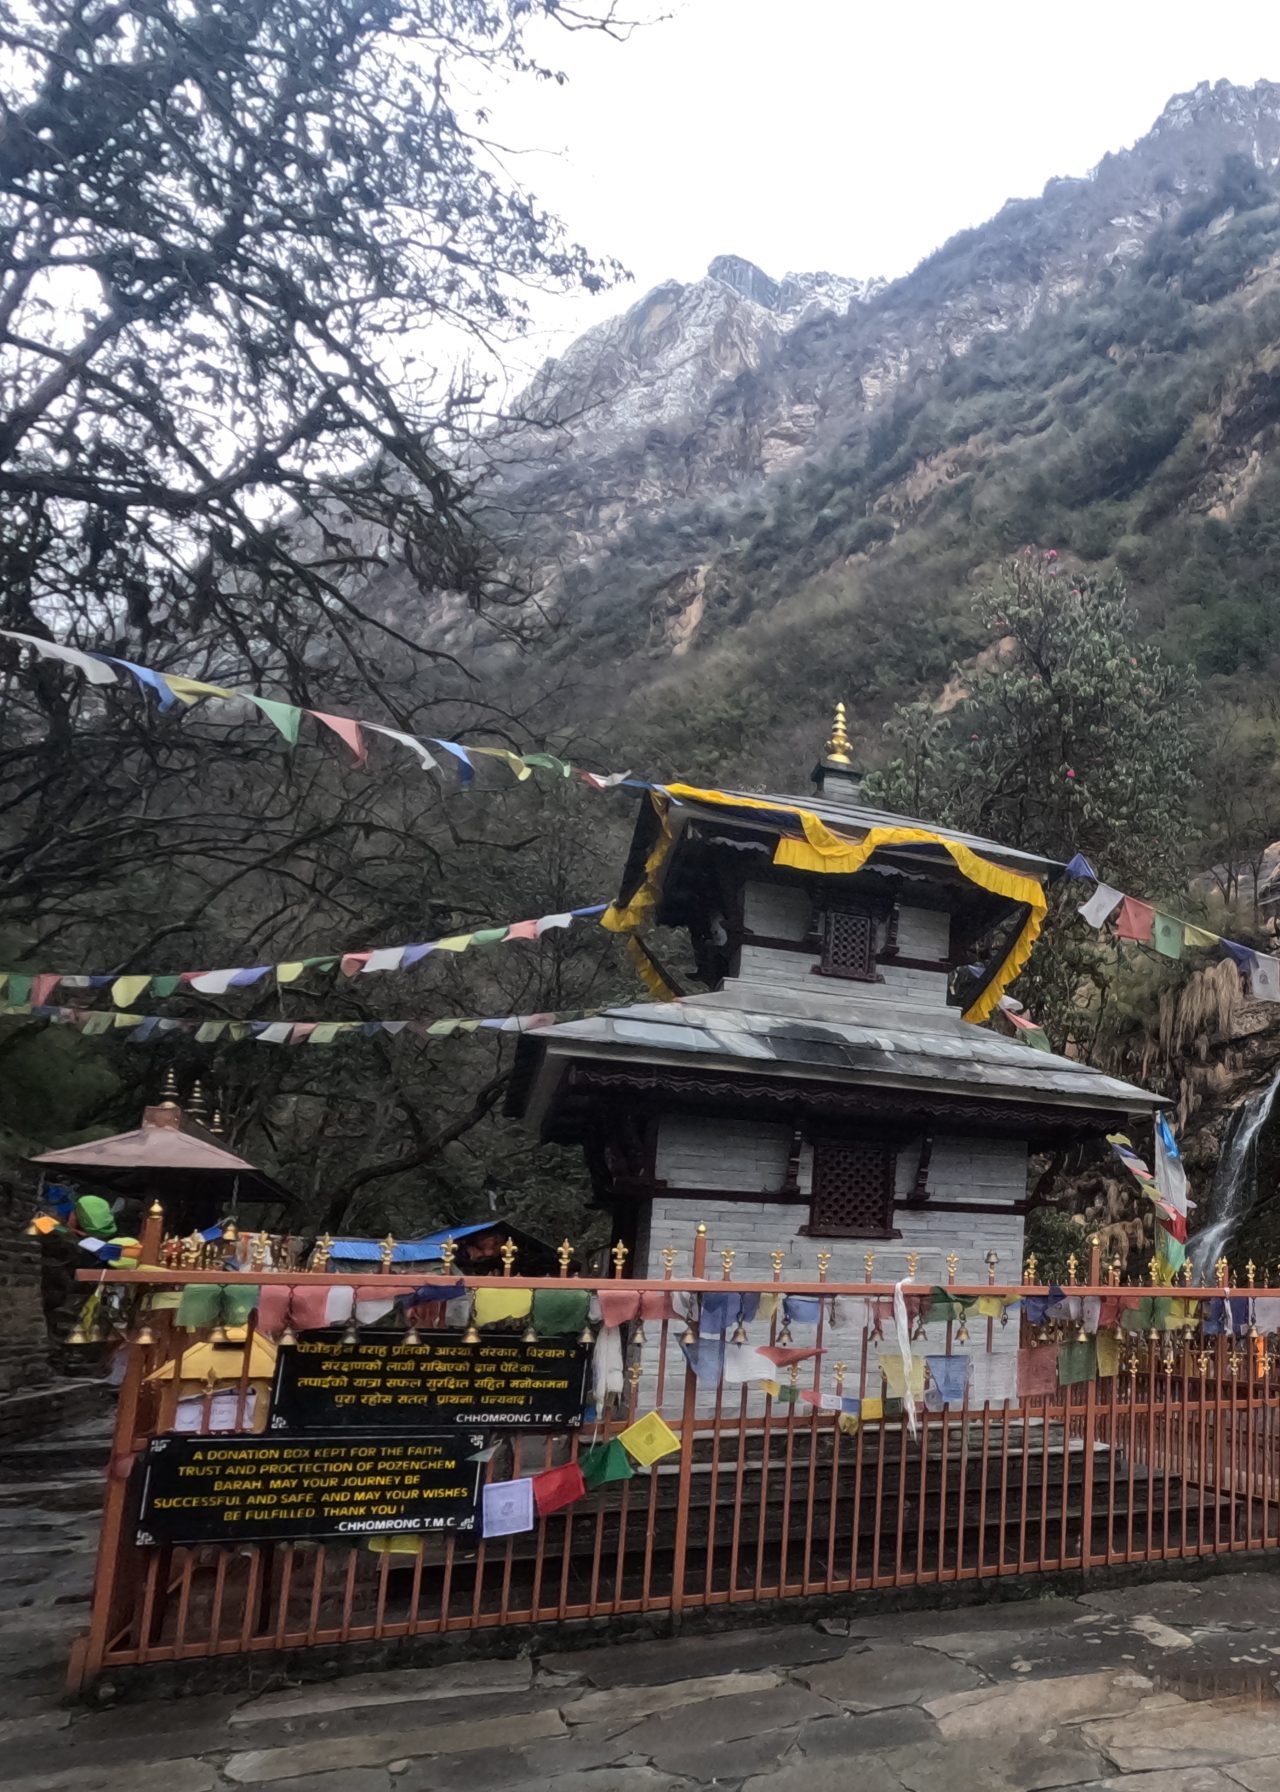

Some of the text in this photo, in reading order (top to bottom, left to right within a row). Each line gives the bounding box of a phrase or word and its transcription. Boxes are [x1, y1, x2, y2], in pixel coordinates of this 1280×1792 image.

[386, 1378, 421, 1388] सफल
[474, 1377, 505, 1391] सहित
[193, 1446, 443, 1461] A DONATION BOX KEPT FOR THE FAITH
[178, 1466, 222, 1476] TRUST
[225, 1465, 257, 1475] AND
[259, 1463, 353, 1474] PROCTECTION
[356, 1462, 374, 1472] OF
[269, 1479, 297, 1489] MAY
[302, 1477, 338, 1488] YOUR
[341, 1475, 401, 1487] JOURNEY
[404, 1475, 421, 1485] BE
[153, 1496, 242, 1508] SUCCESSFUL
[247, 1495, 277, 1505] AND
[320, 1492, 350, 1502] AND
[353, 1491, 382, 1501] MAY
[385, 1489, 419, 1499] YOUR
[422, 1487, 469, 1498] WISHES
[223, 1511, 241, 1521] BE
[323, 1506, 367, 1517] THANK
[370, 1504, 397, 1514] YOU
